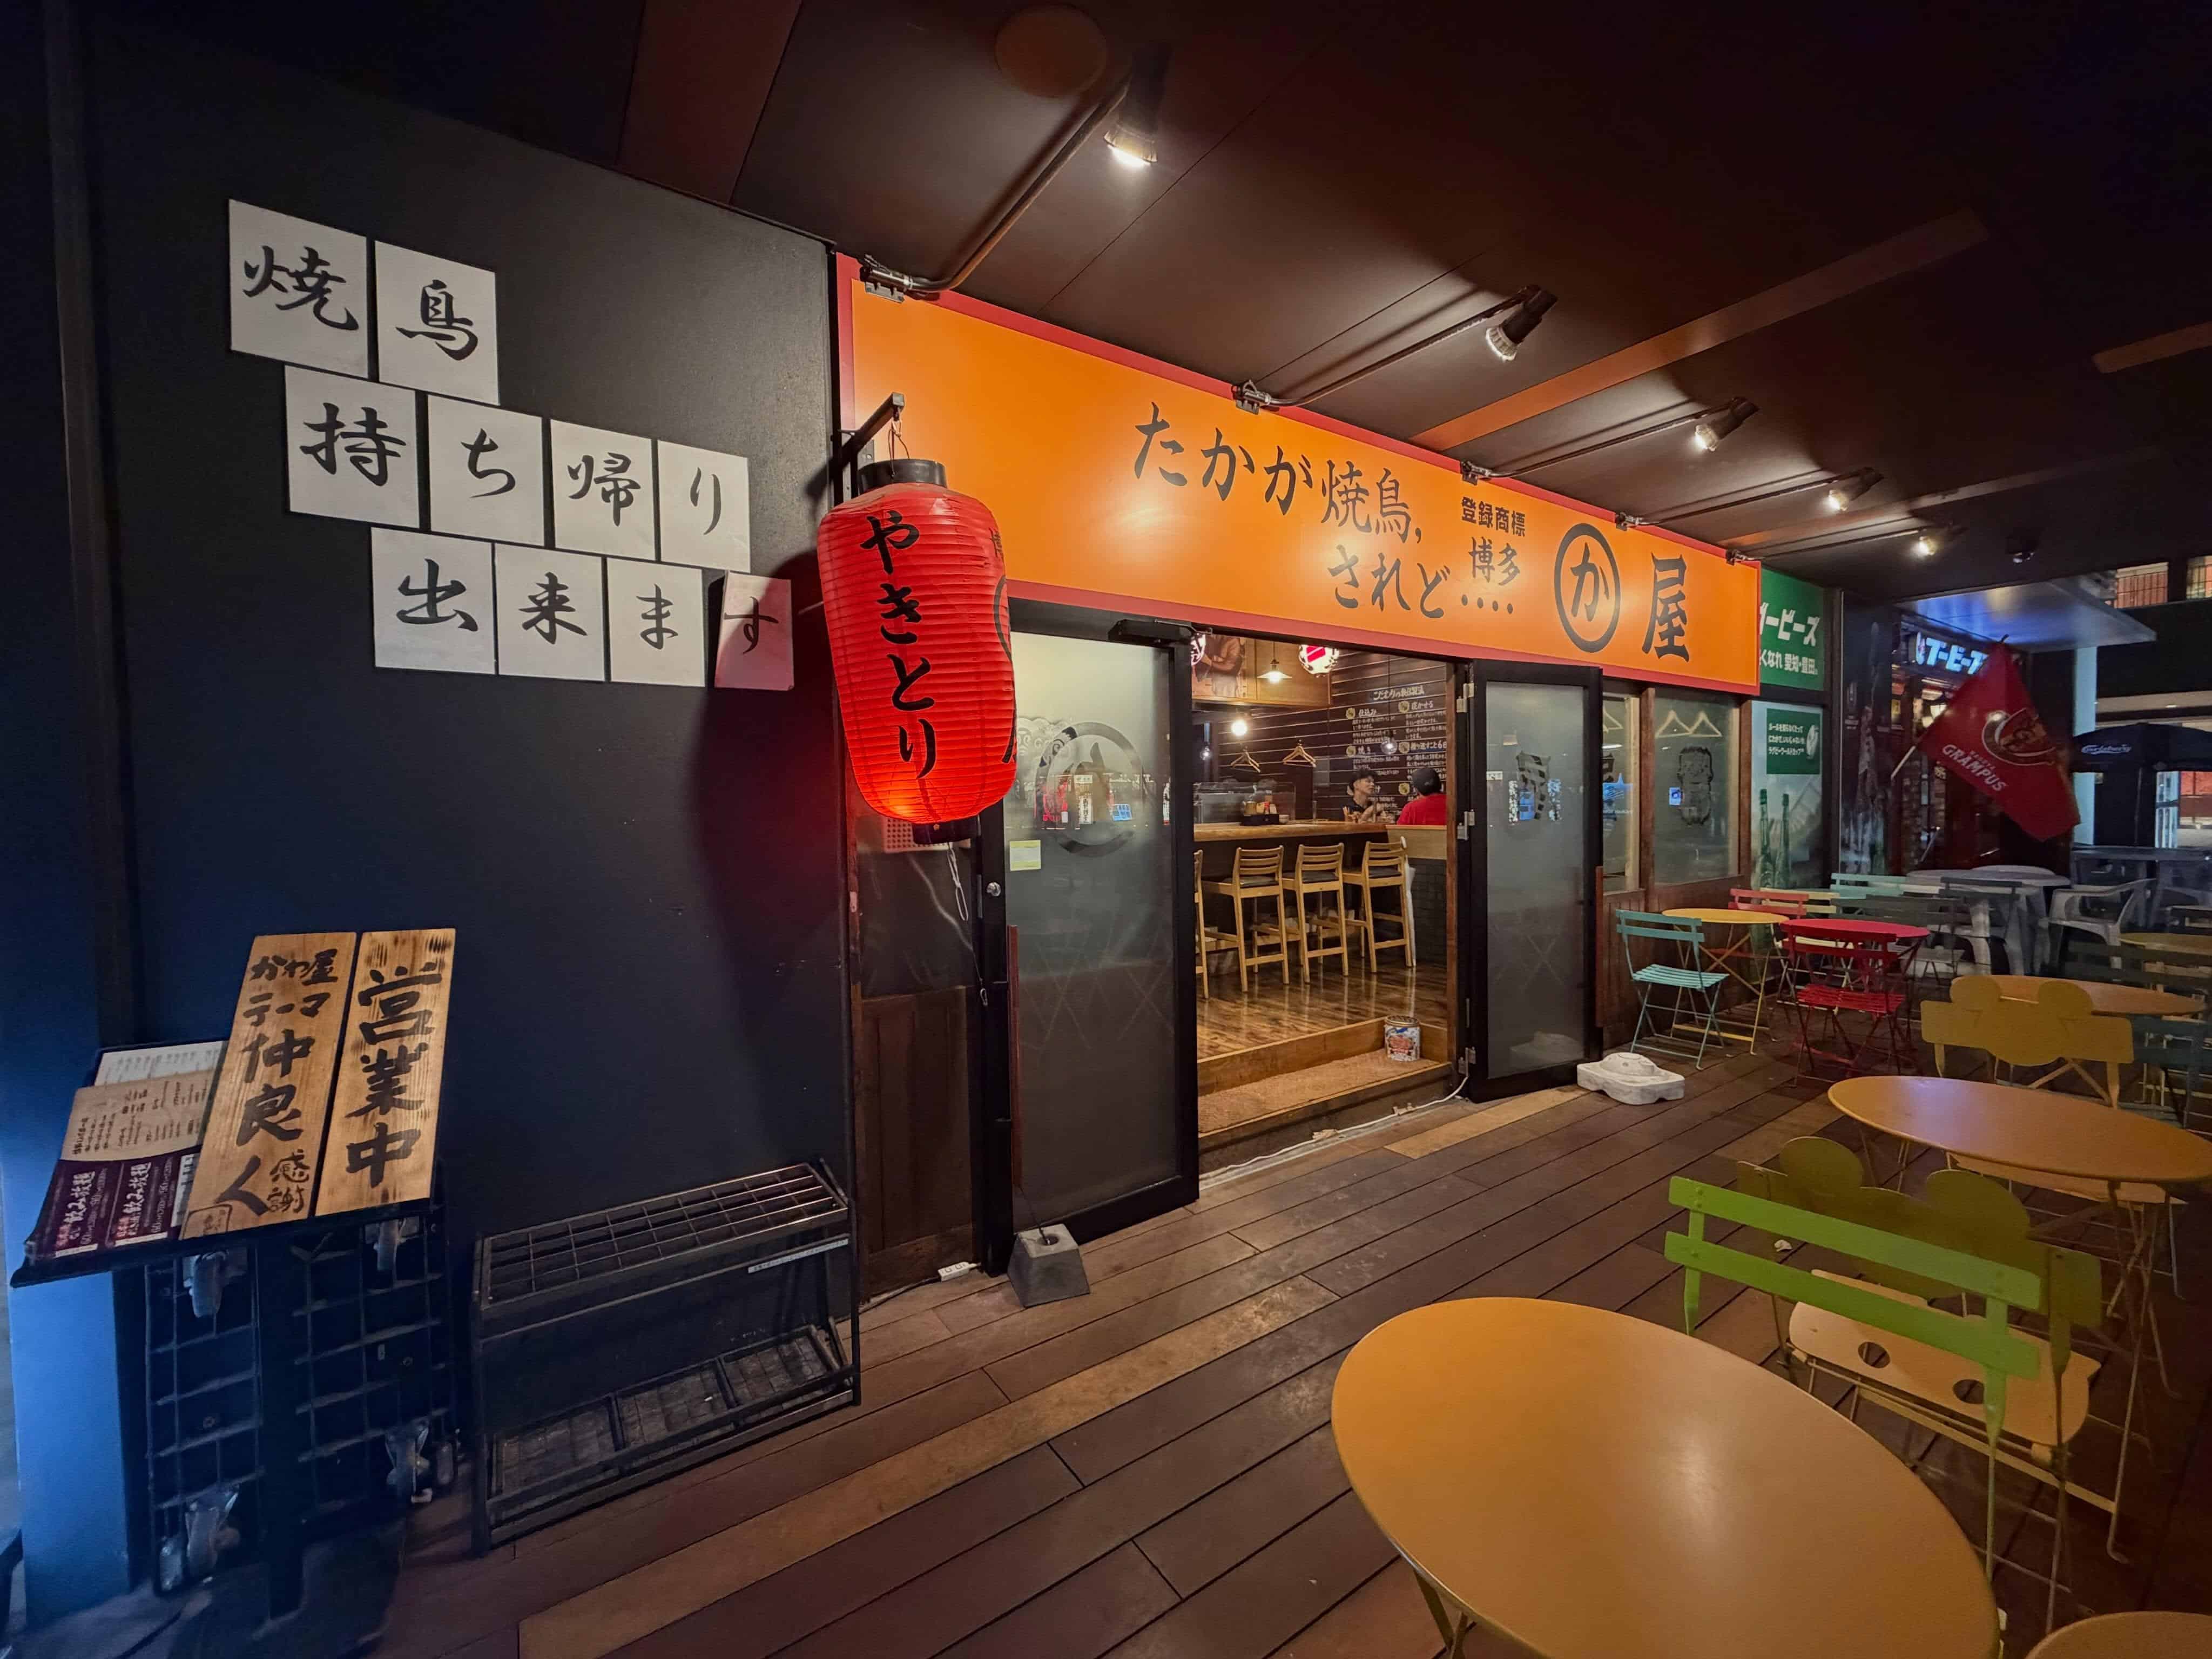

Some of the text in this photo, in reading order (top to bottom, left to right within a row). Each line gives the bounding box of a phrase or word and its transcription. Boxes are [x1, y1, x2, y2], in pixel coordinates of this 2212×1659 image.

[243, 246, 479, 361] 焼鳥
[299, 402, 722, 535] 持ち帰り
[1459, 496, 1526, 537] 登録商標
[1468, 536, 1520, 586] 博多
[396, 558, 779, 655] 出来ます
[859, 510, 936, 779] やきとり
[1760, 649, 1783, 669] くなれ
[1942, 744, 2009, 791] GRAMPUS
[249, 949, 339, 986] かわ屋
[243, 992, 331, 1026] テーマ
[345, 962, 443, 1189] 営業中
[63, 1171, 96, 1224] 飲み放題
[123, 1162, 152, 1215] 飲み放題
[267, 1149, 310, 1213] 感謝
